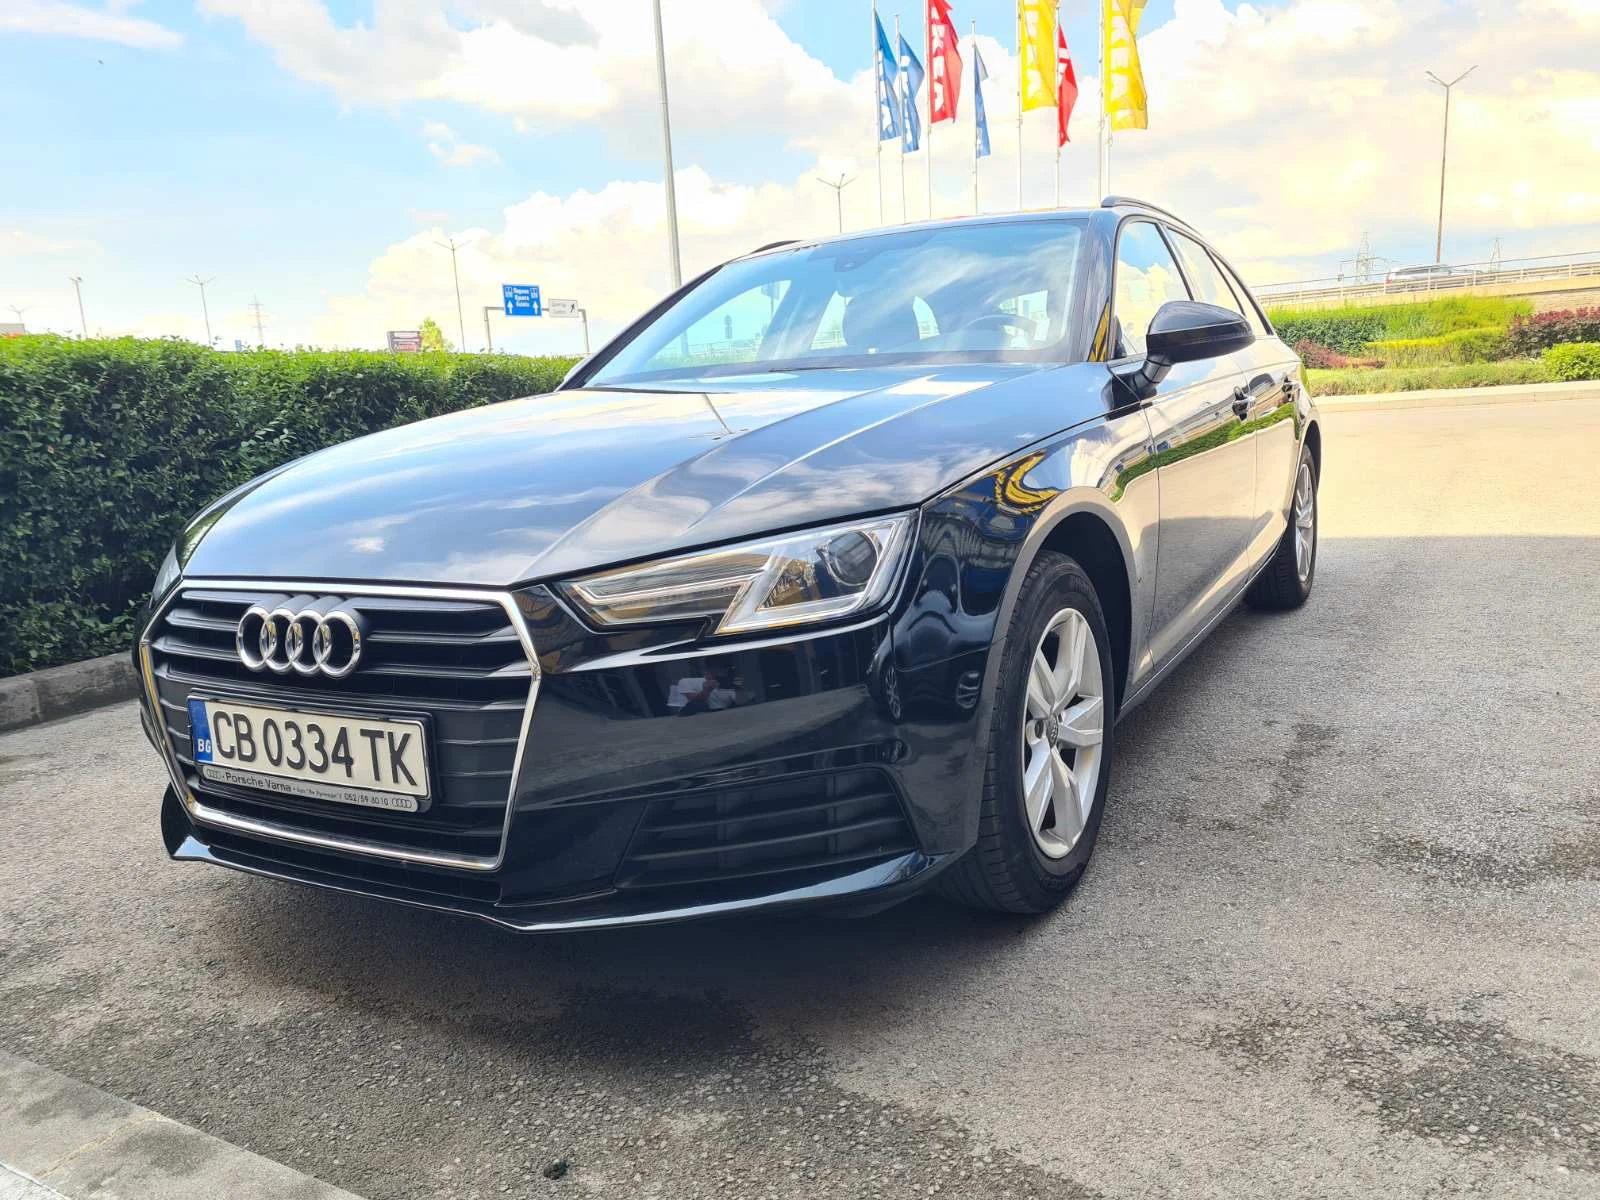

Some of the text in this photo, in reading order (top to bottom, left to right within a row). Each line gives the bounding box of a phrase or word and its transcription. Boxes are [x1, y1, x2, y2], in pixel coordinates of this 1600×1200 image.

[197, 738, 212, 753] BG
[212, 710, 418, 786] CB 0334 TK
[225, 773, 264, 788] Porsche
[264, 778, 292, 793] Varna
